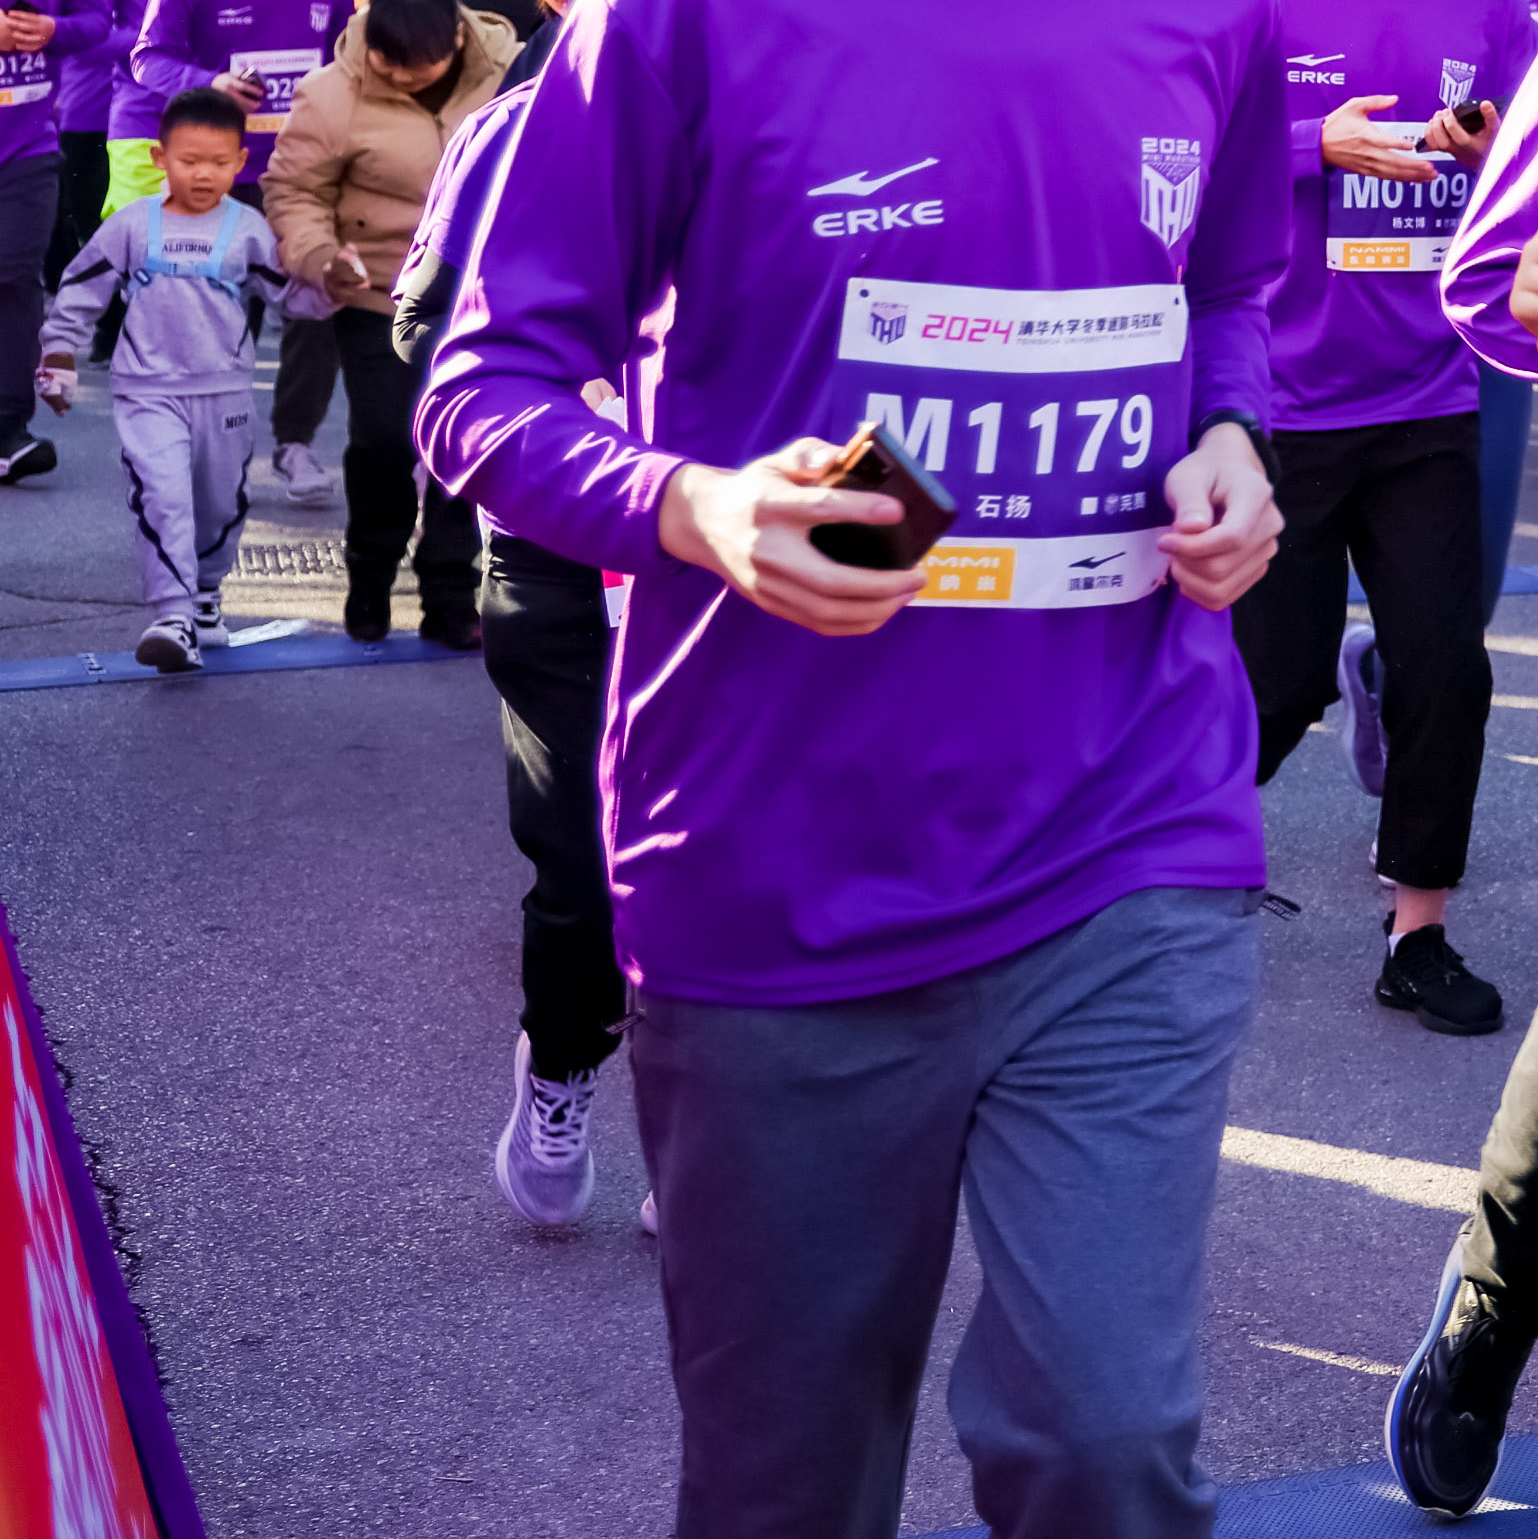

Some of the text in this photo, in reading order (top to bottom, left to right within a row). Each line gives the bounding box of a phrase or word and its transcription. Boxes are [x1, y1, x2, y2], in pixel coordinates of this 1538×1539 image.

[1287, 70, 1346, 85] ERKE
[1141, 137, 1200, 156] 2024
[1343, 172, 1468, 209] M0109
[813, 200, 945, 238] ERKE
[1349, 246, 1406, 254] NAMMI
[920, 313, 1014, 345] 2024
[864, 392, 1153, 476] M1179
[975, 494, 1032, 519] 石扬
